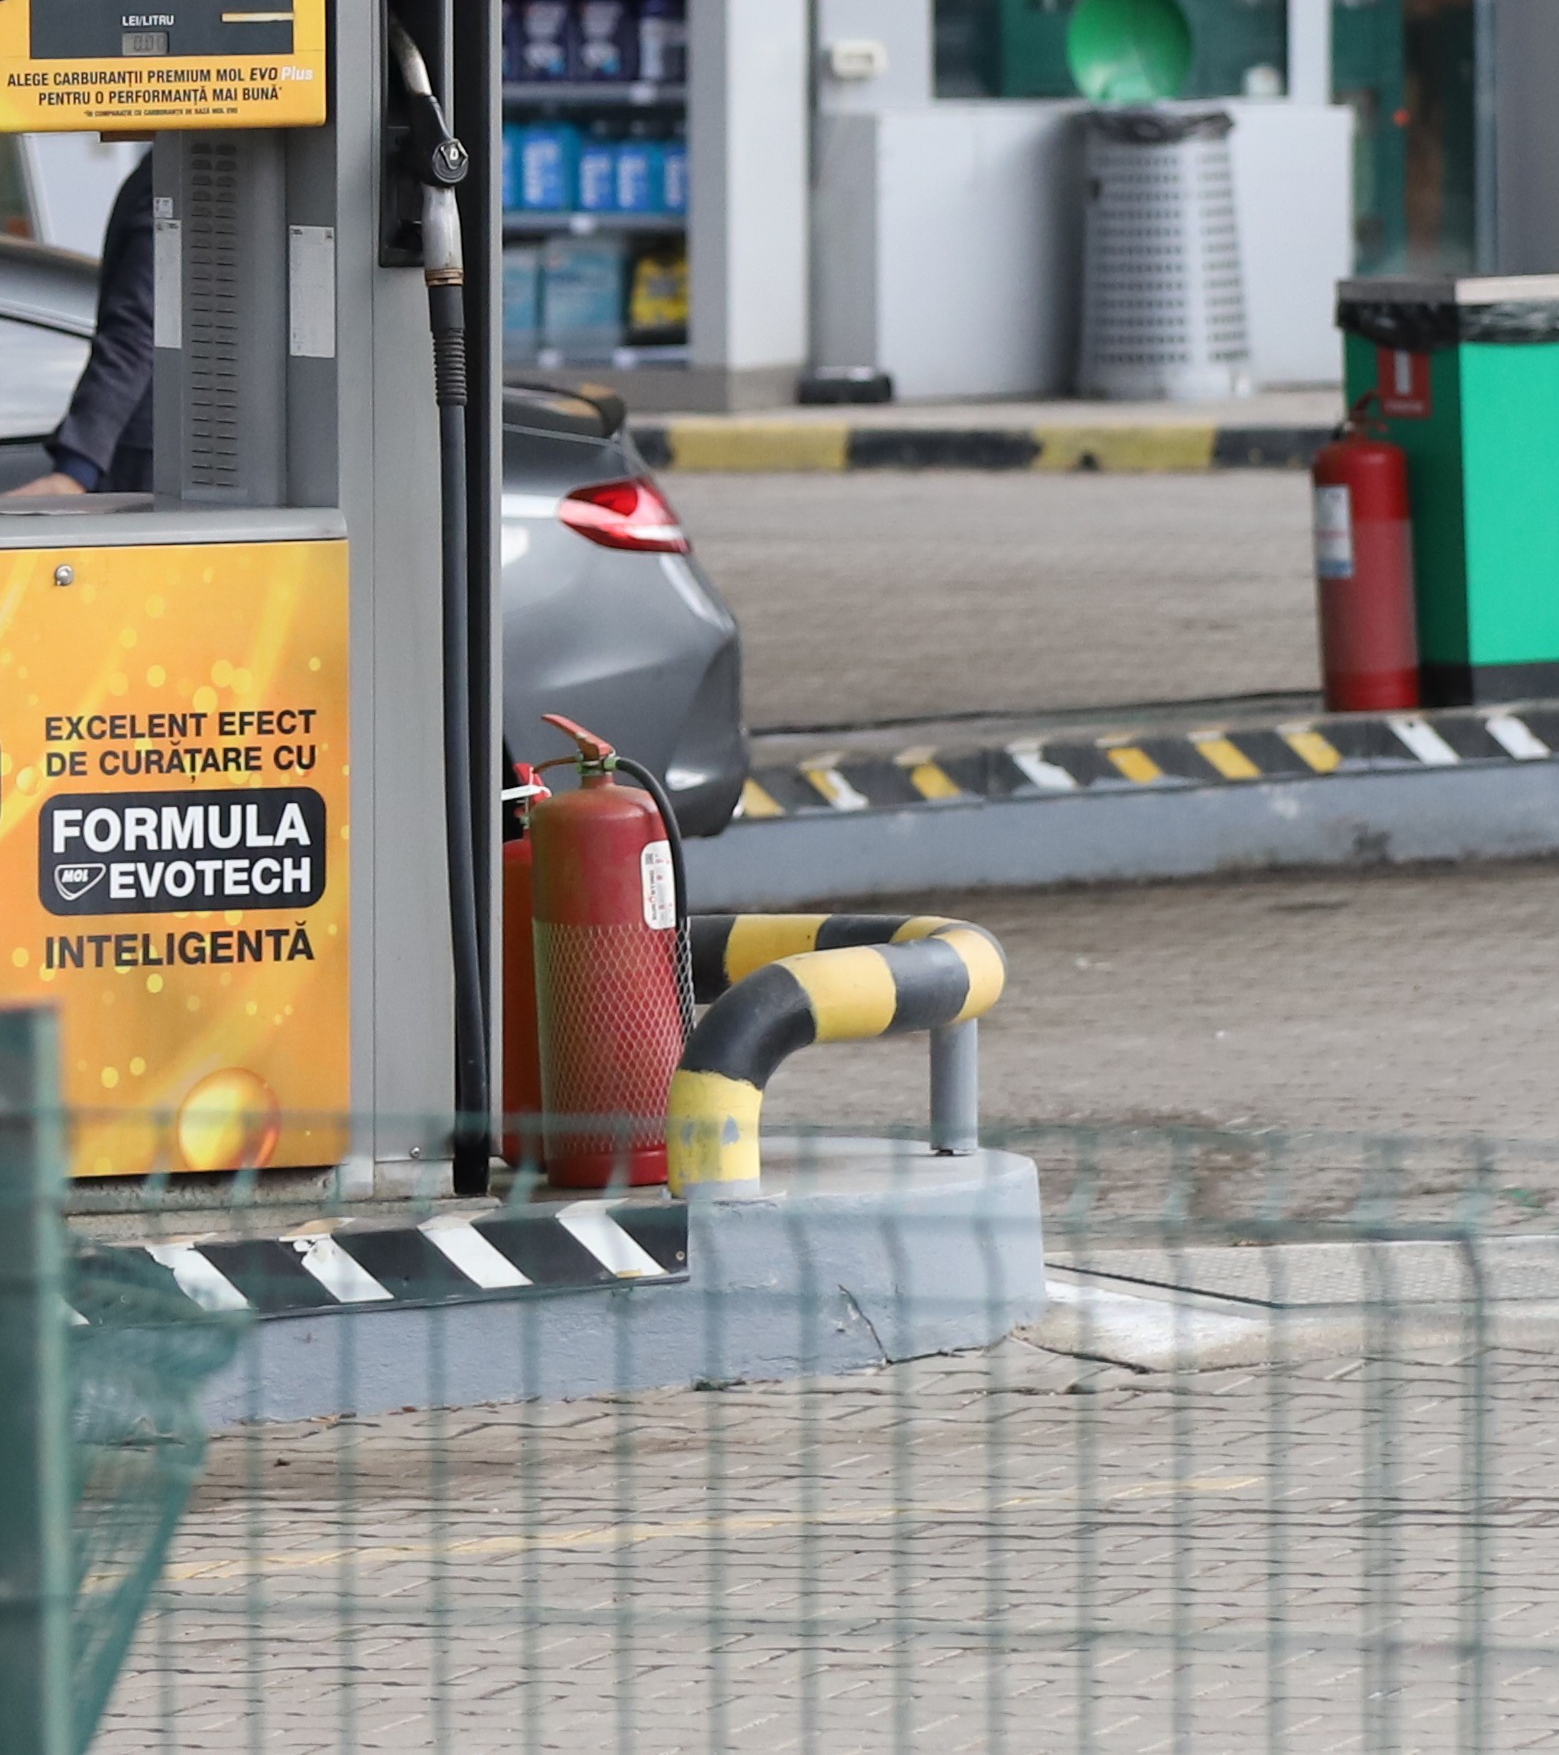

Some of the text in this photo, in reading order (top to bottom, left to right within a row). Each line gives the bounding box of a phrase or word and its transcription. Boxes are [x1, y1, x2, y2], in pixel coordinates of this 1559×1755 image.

[122, 14, 175, 27] LEI/LITRU
[7, 70, 49, 87] ALEGE
[147, 68, 212, 85] PREMIUM
[216, 68, 245, 83] MOL
[248, 67, 279, 82] EVO
[281, 65, 314, 82] Plus
[38, 91, 91, 106] PENTRU
[94, 90, 105, 105] O
[212, 88, 239, 103] MAI
[45, 709, 317, 742] EXCELENT EFECT
[46, 740, 317, 783] DE CURĂȚARE CU
[52, 802, 312, 854] FORMULA
[61, 856, 312, 899] MOL EVOTECH
[45, 919, 316, 970] INTELIGENTĂ
